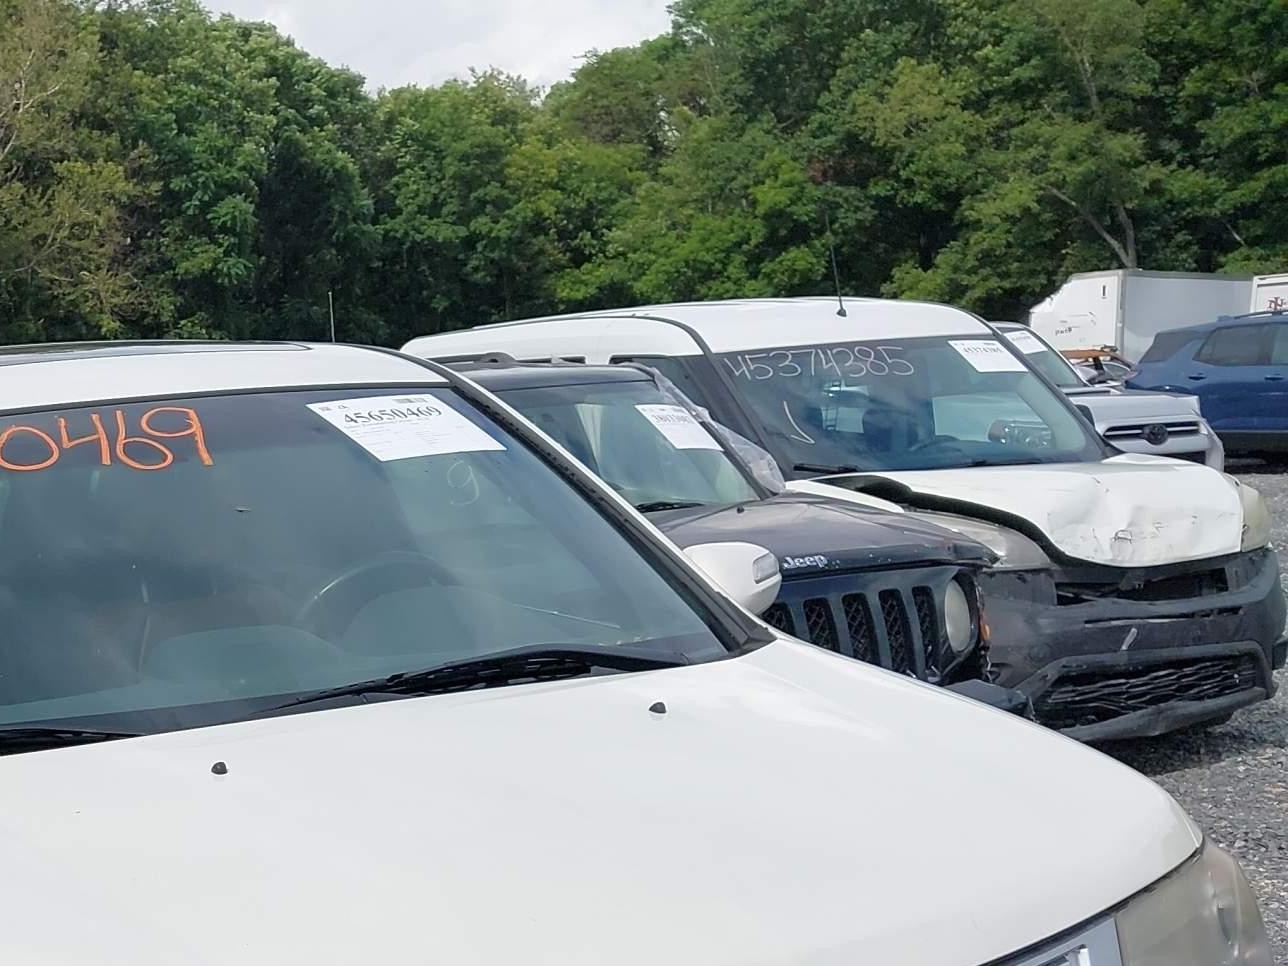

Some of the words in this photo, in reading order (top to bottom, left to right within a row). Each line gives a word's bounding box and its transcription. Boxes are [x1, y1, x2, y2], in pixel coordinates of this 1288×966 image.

[724, 346, 914, 381] 45374385
[343, 405, 443, 425] 45650469
[783, 554, 828, 569] Jeep
